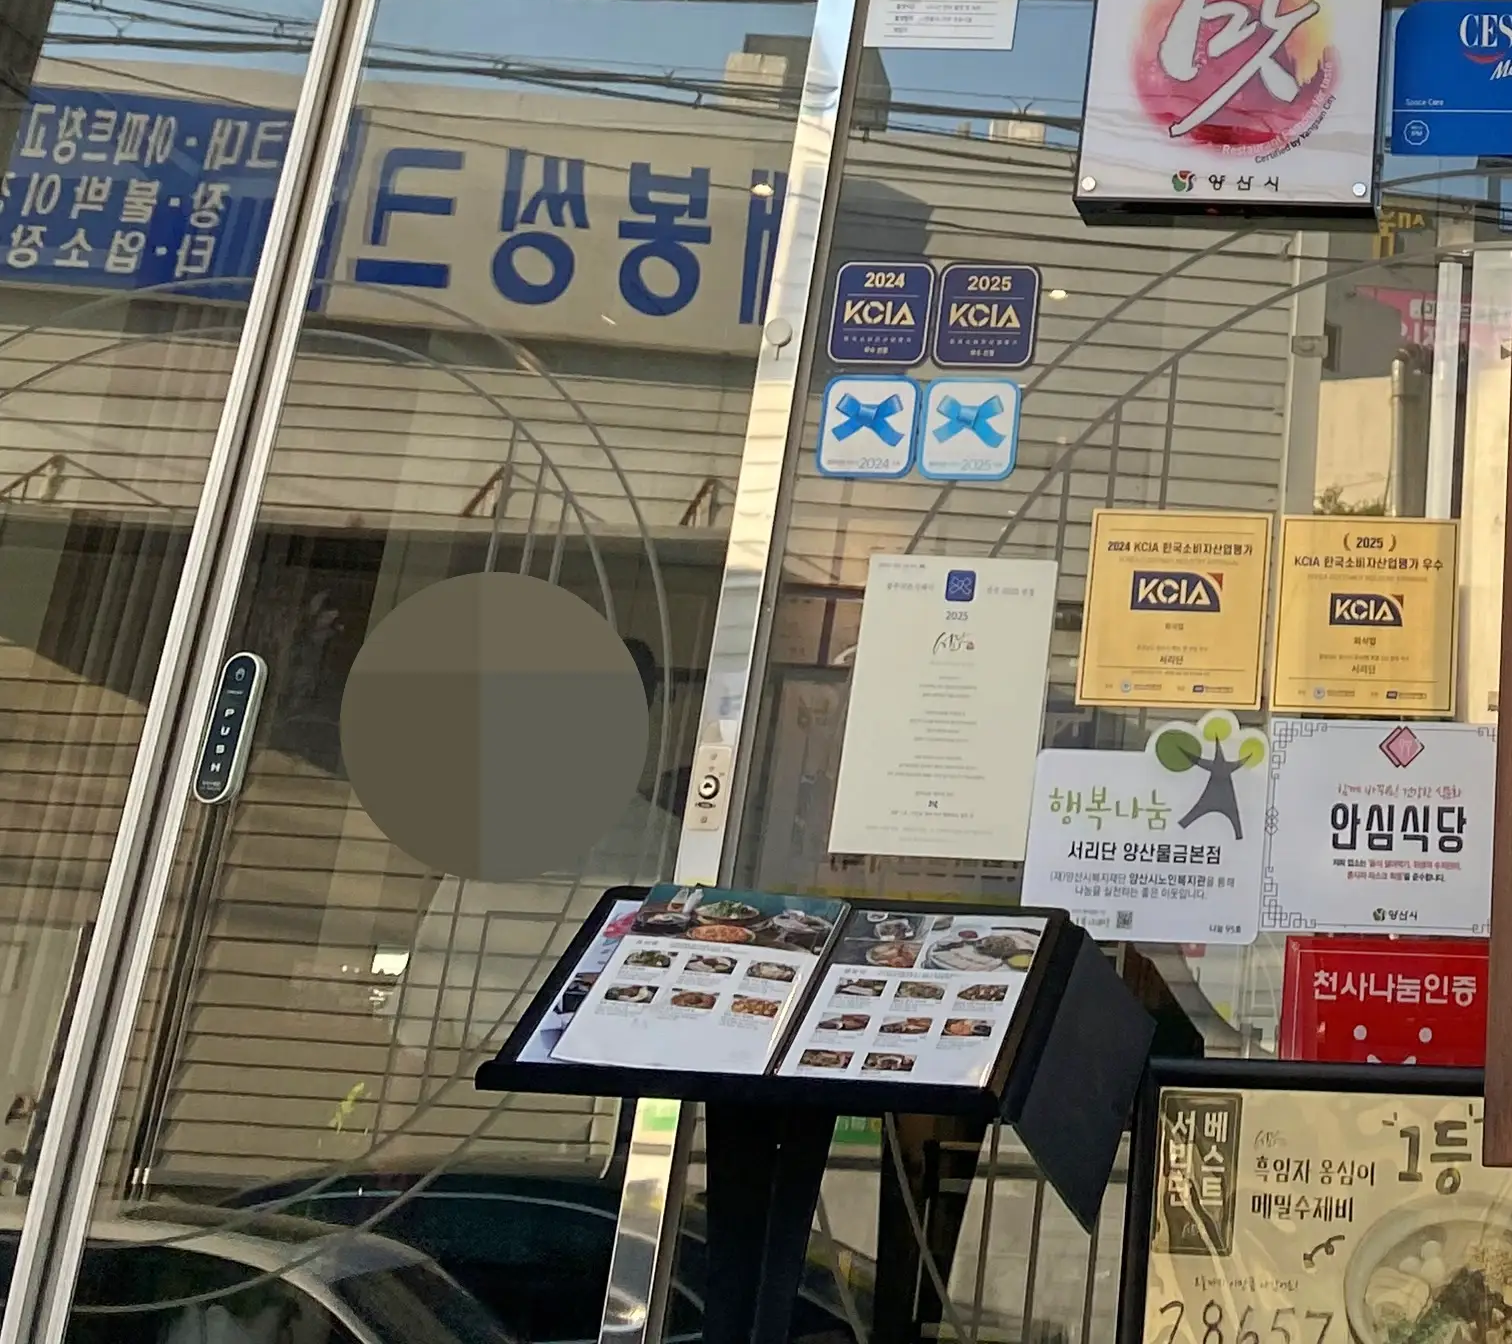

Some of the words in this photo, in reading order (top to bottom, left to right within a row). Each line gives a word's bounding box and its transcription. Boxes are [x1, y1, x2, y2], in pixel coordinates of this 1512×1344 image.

[1254, 142, 1292, 164] Certified
[1290, 138, 1302, 149] by
[1299, 110, 1328, 140] Yangsan
[1322, 93, 1337, 111] City
[1208, 174, 1280, 192] 양산시
[864, 272, 906, 289] 2024
[967, 275, 1013, 292] 2025
[843, 300, 916, 326] KCIA
[949, 303, 1021, 329] KCIA
[858, 456, 890, 470] 2024
[1107, 541, 1131, 553] 2024
[1133, 541, 1159, 553] KCIA
[1162, 543, 1253, 556] 한국소비자산업평가
[1356, 536, 1384, 549] 2025
[1294, 555, 1320, 567] KCIA
[1323, 555, 1419, 570] 한국소비자산업평가
[1422, 558, 1444, 571] 우수
[1137, 577, 1211, 605] KCIA
[945, 611, 968, 621] 2025
[1335, 598, 1394, 621] KCIA
[1049, 785, 1172, 831] 행복나눔
[1330, 802, 1467, 853] 안심식당
[1067, 840, 1117, 861] 서리단
[1123, 843, 1222, 865] 양산물금본점
[1313, 969, 1477, 1007] 천사나눔인증
[1200, 1111, 1228, 1207] 베스트
[1399, 1120, 1473, 1195] 1등
[1254, 1155, 1311, 1184] 흑임자
[1319, 1160, 1376, 1187] 옹심이
[1251, 1193, 1355, 1223] 메밀수제비
